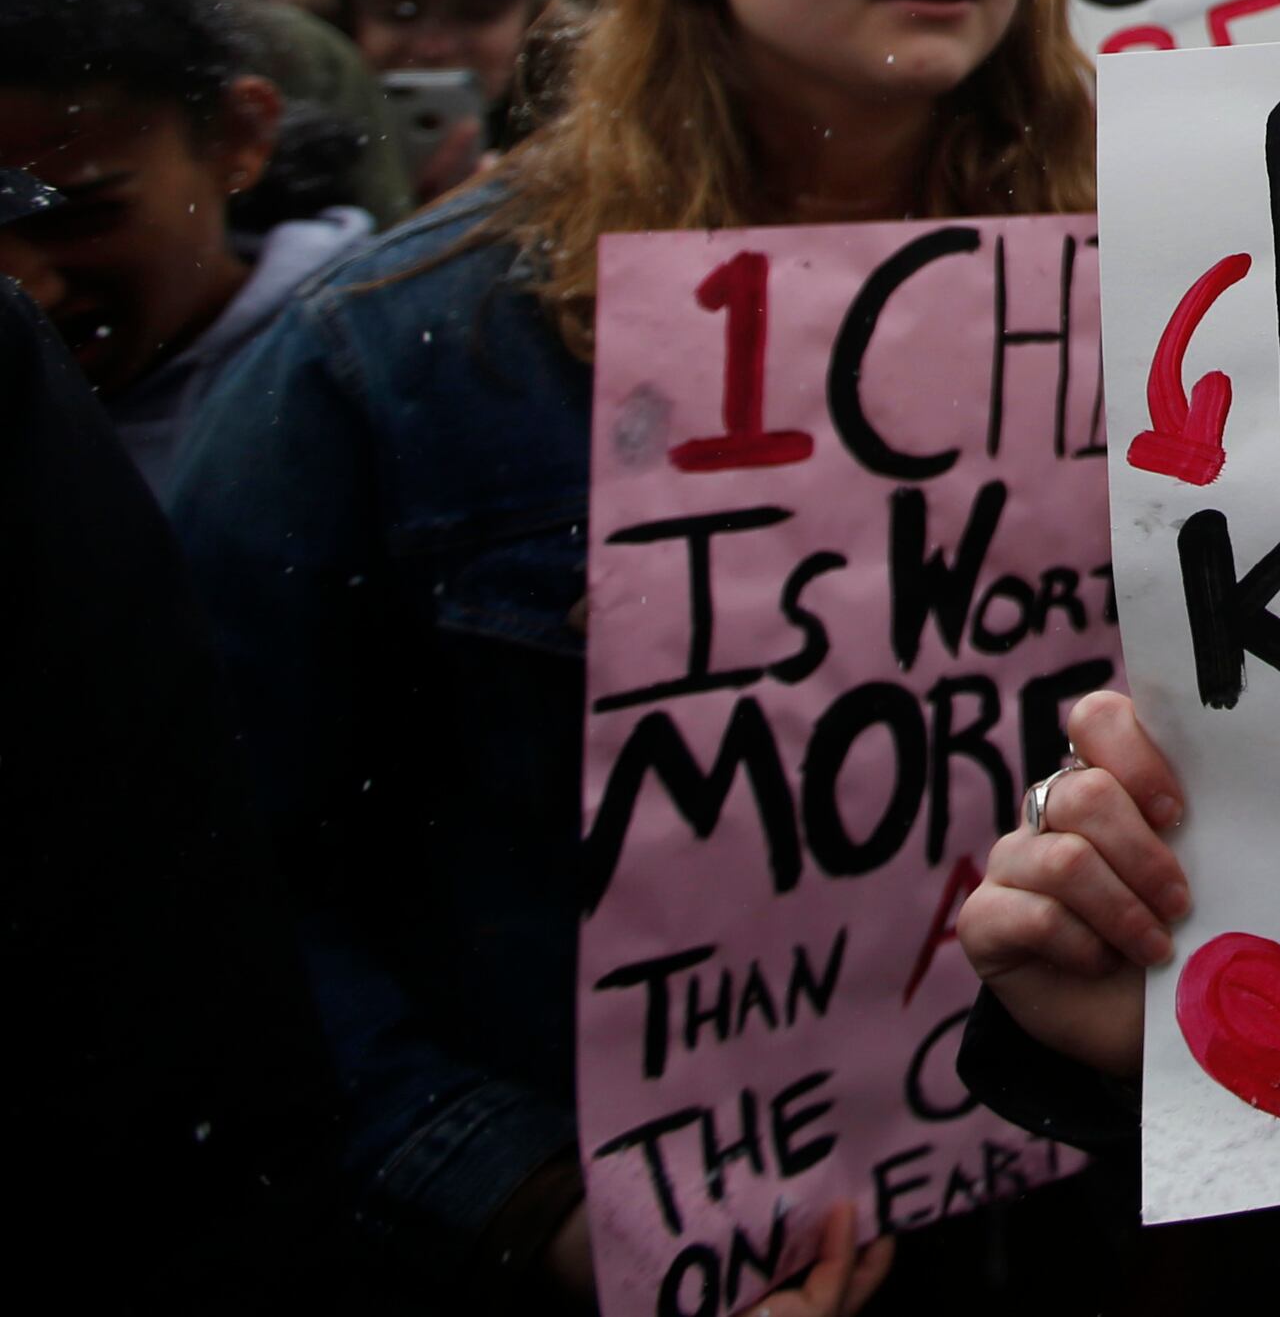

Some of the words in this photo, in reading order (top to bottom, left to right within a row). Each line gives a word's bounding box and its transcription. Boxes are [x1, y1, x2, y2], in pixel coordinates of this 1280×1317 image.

[667, 249, 815, 474] 1
[592, 925, 848, 1080] THAN
[592, 1069, 839, 1237] THE
